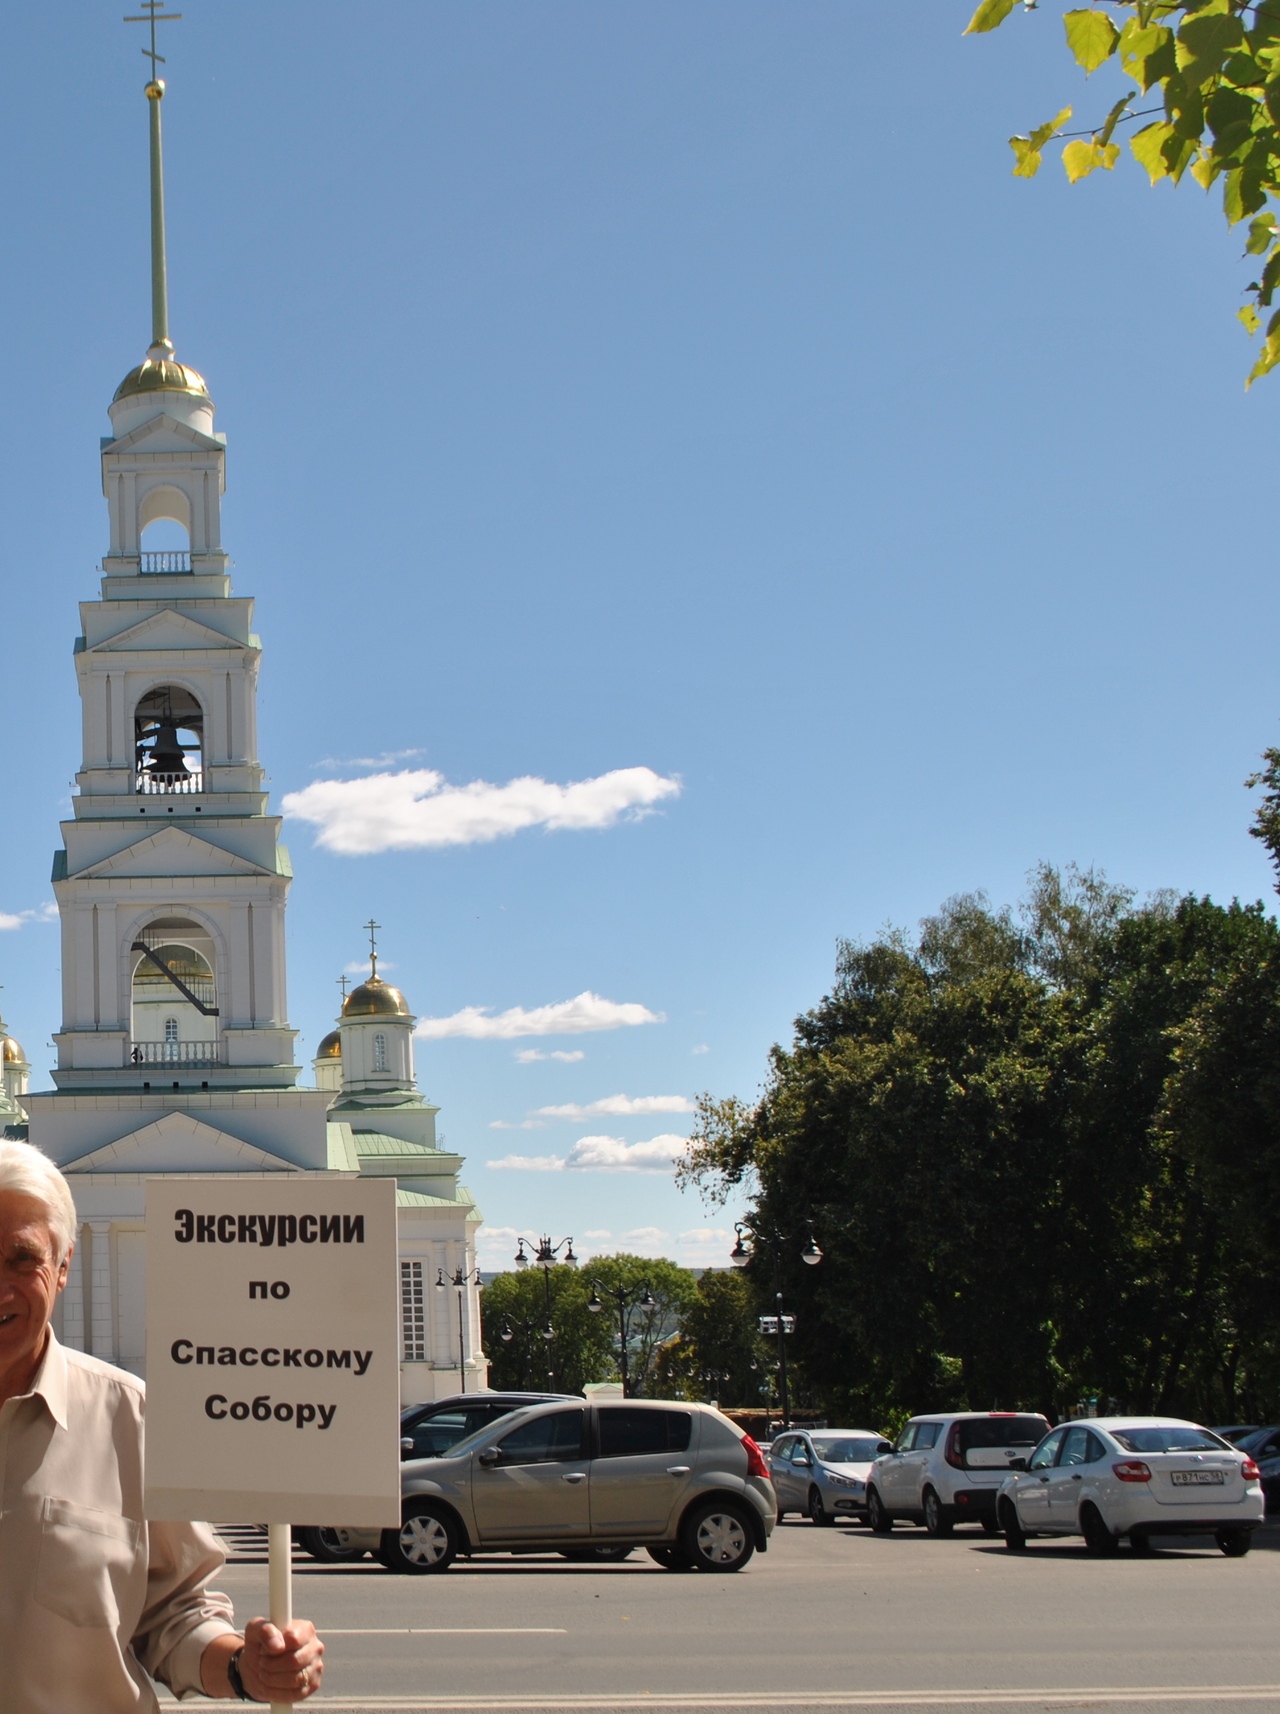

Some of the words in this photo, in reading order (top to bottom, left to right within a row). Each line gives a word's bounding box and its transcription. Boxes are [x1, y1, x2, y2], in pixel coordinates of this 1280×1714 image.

[174, 1208, 365, 1248] Экскурсии
[248, 1280, 291, 1300] по
[170, 1338, 374, 1376] Спасскому
[204, 1393, 337, 1430] Собору
